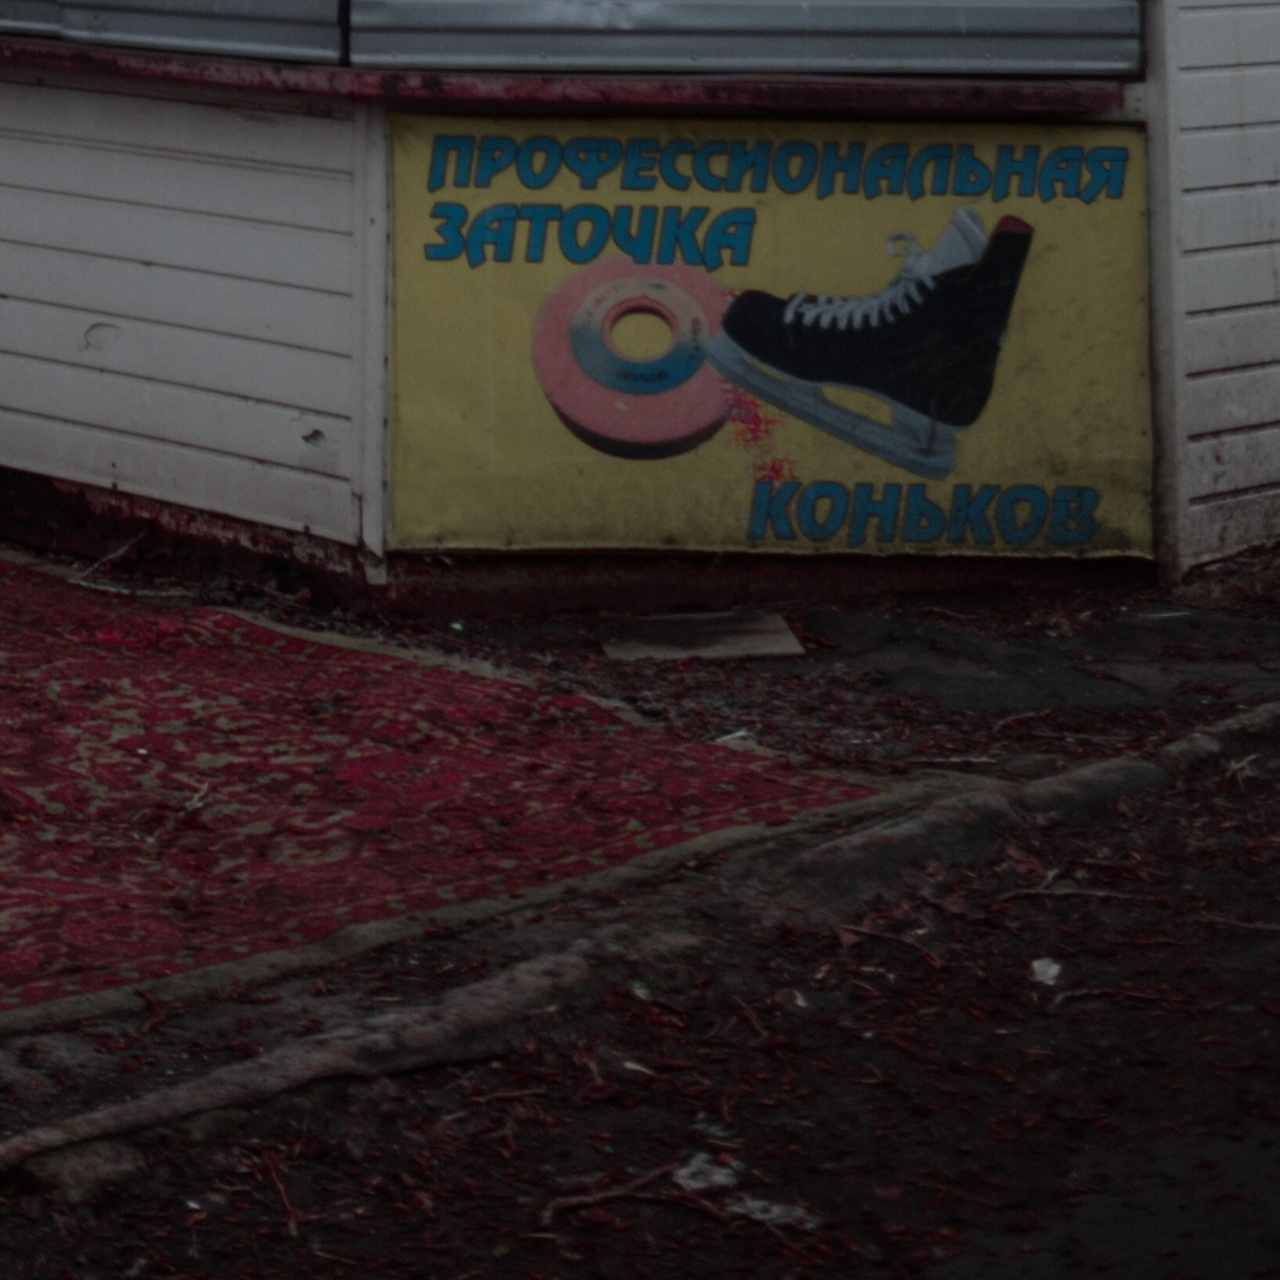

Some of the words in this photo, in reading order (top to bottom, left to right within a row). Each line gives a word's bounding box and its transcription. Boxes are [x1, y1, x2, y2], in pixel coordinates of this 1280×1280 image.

[427, 135, 1129, 204] ПРОФЕССИОНАЛЬНАЯ
[424, 203, 757, 270] ЗАТОЧКА
[747, 480, 1101, 548] КОНЬКОВ
